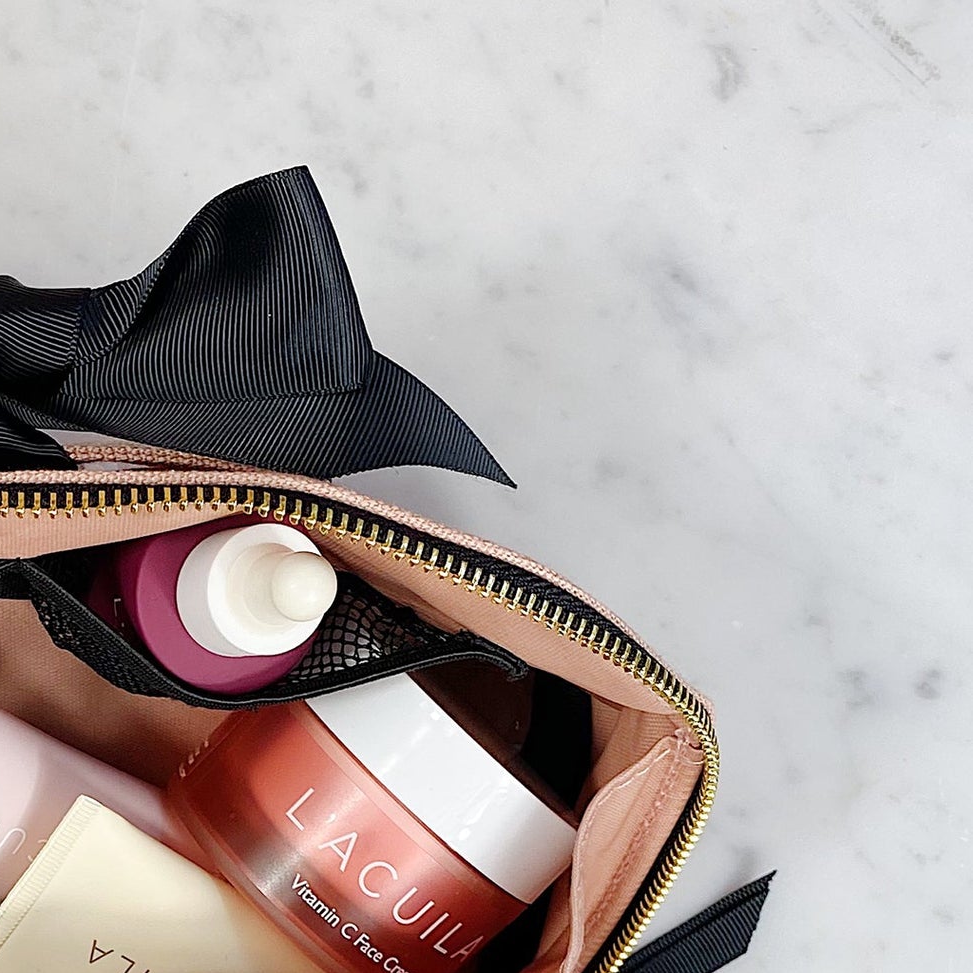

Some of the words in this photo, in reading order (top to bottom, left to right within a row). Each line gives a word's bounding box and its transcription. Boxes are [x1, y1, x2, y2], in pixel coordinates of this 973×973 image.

[290, 873, 341, 928] Vitamin
[340, 922, 359, 940] C
[353, 933, 384, 963] Face
